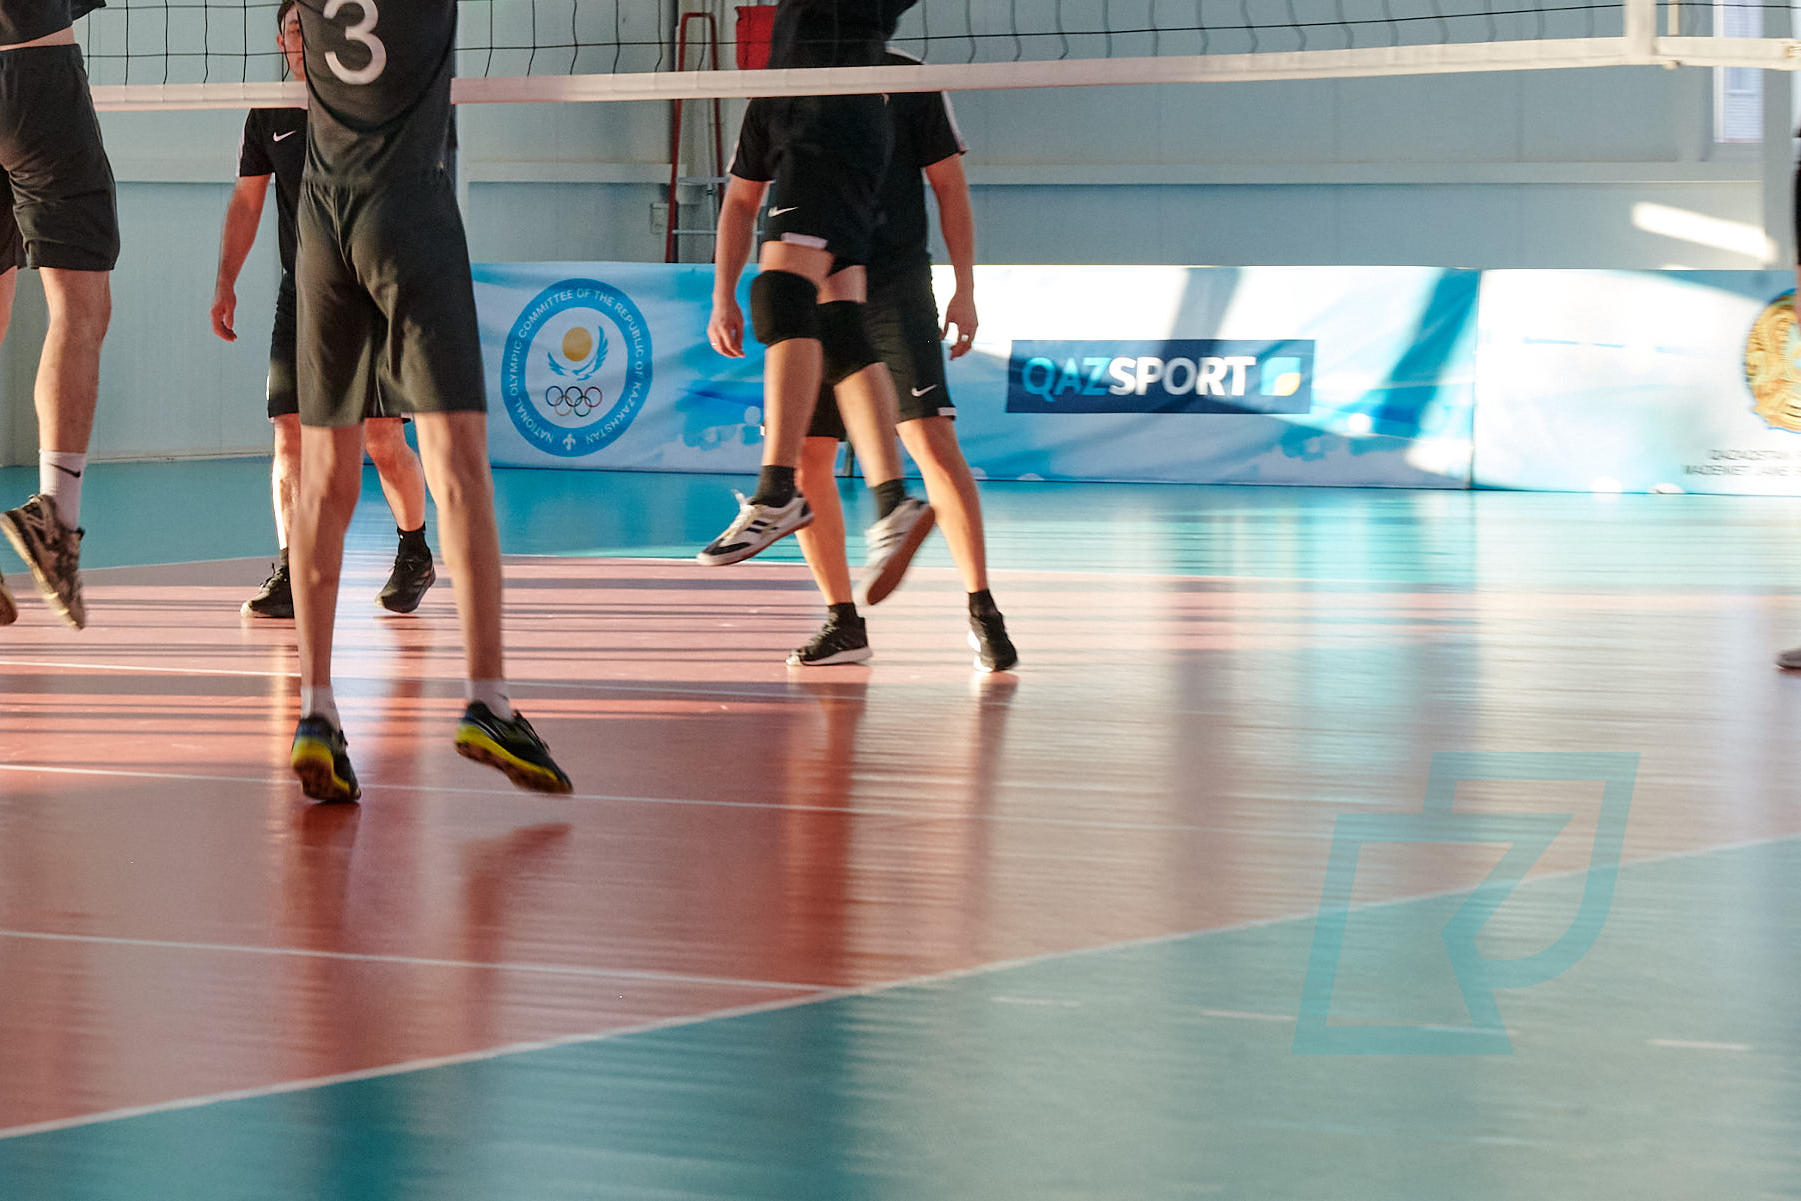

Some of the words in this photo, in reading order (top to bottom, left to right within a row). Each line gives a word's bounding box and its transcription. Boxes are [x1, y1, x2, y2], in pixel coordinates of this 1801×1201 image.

[518, 289, 574, 339] COMMITTEE
[576, 288, 591, 299] OF
[594, 290, 614, 307] THE
[614, 302, 645, 357] REPUBLIC
[510, 340, 523, 396] OLYMPIC
[635, 360, 645, 377] OF
[1021, 356, 1257, 403] QAZSPORT
[510, 397, 555, 443] NATIONAL
[585, 381, 643, 444] KAZAKHSTAN
